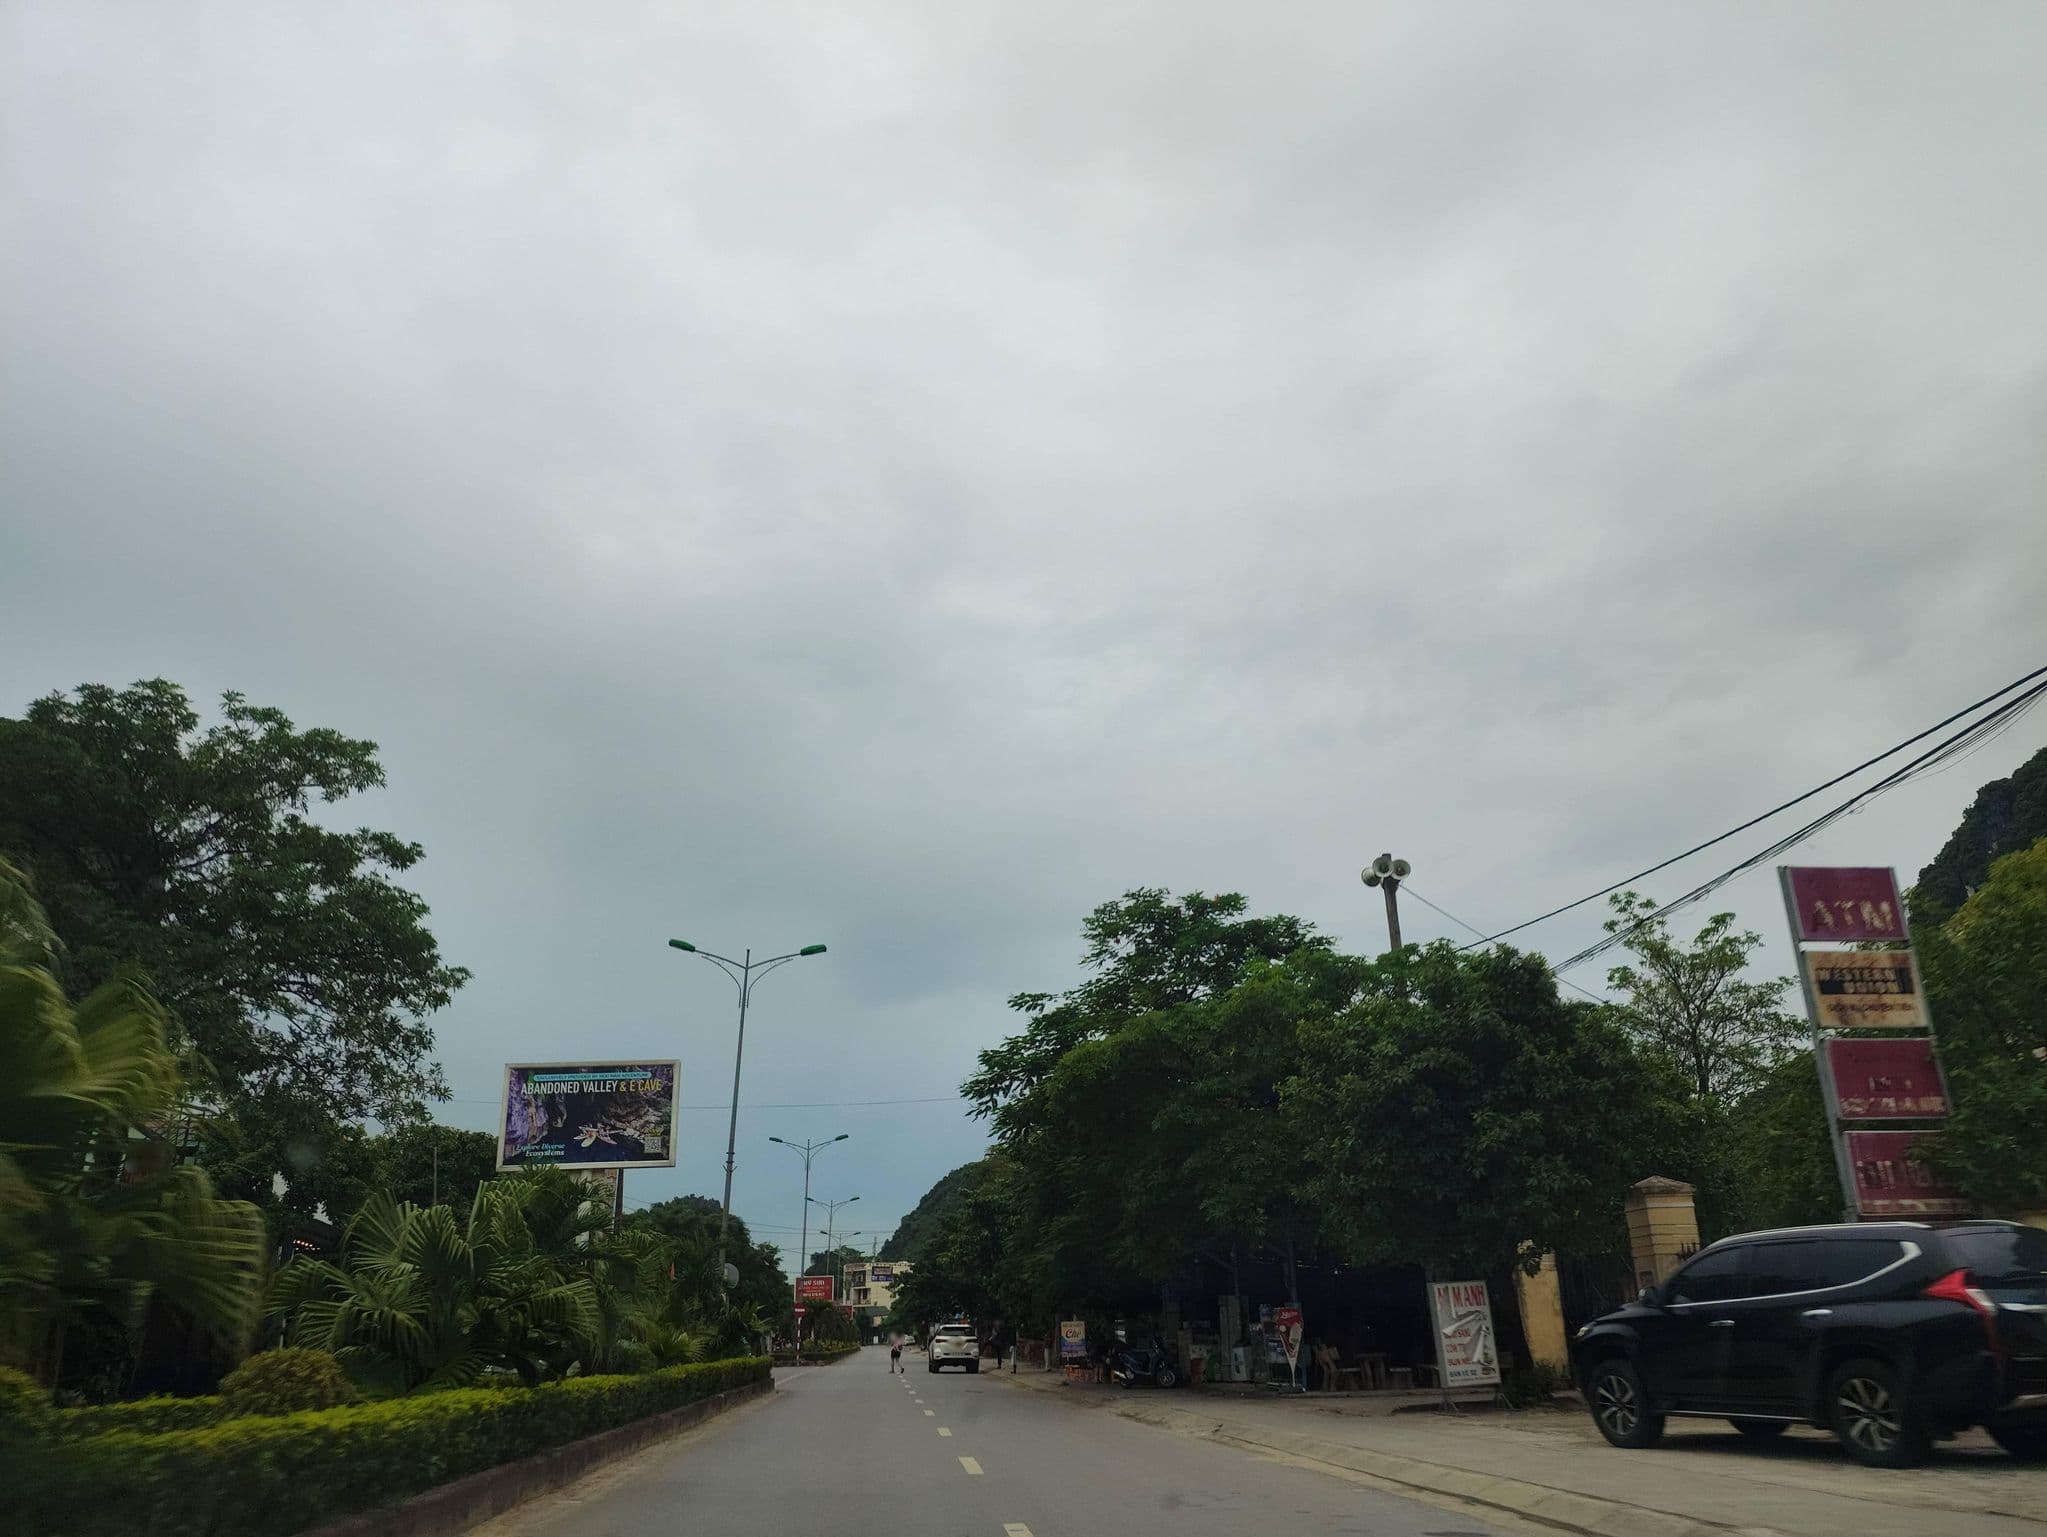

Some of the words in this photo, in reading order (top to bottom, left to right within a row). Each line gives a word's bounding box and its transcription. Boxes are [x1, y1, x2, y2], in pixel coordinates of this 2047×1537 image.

[1812, 899, 1896, 933] ATM
[1816, 968, 1897, 981] WESTERN
[1843, 981, 1901, 994] UNION
[521, 1081, 580, 1095] ABANDONED
[583, 1080, 618, 1094] VALLEY
[619, 1081, 627, 1092] &
[638, 1078, 662, 1092] CAVE
[525, 1150, 565, 1158] Ecosystems
